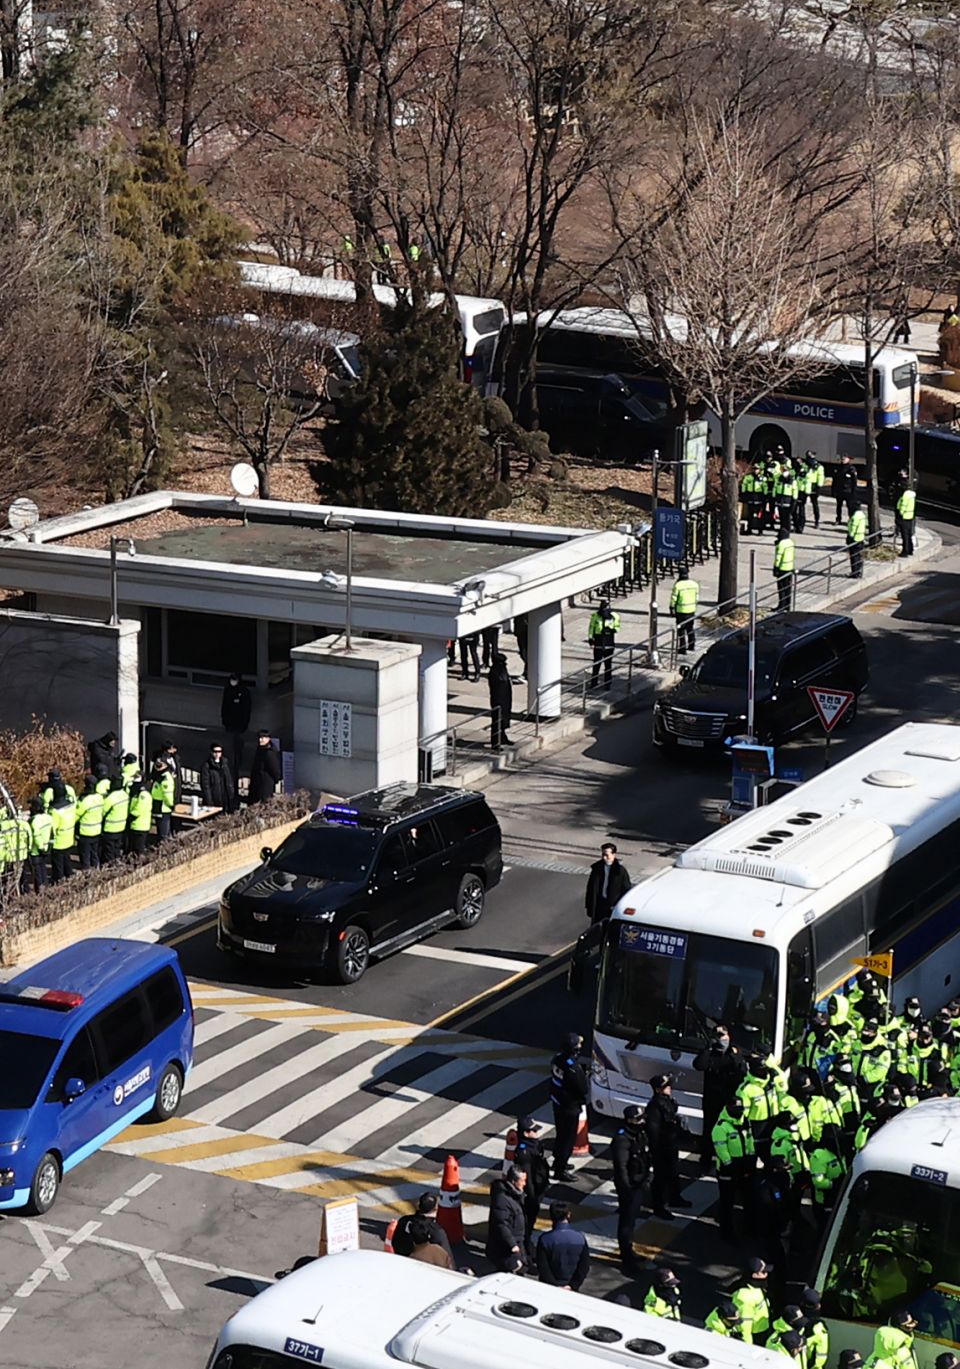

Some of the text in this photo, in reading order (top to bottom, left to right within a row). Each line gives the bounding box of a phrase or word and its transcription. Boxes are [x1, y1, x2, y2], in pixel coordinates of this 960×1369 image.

[793, 404, 835, 420] POLICE
[914, 1165, 945, 1182] 33기-2
[288, 1340, 320, 1360] 37기-1
